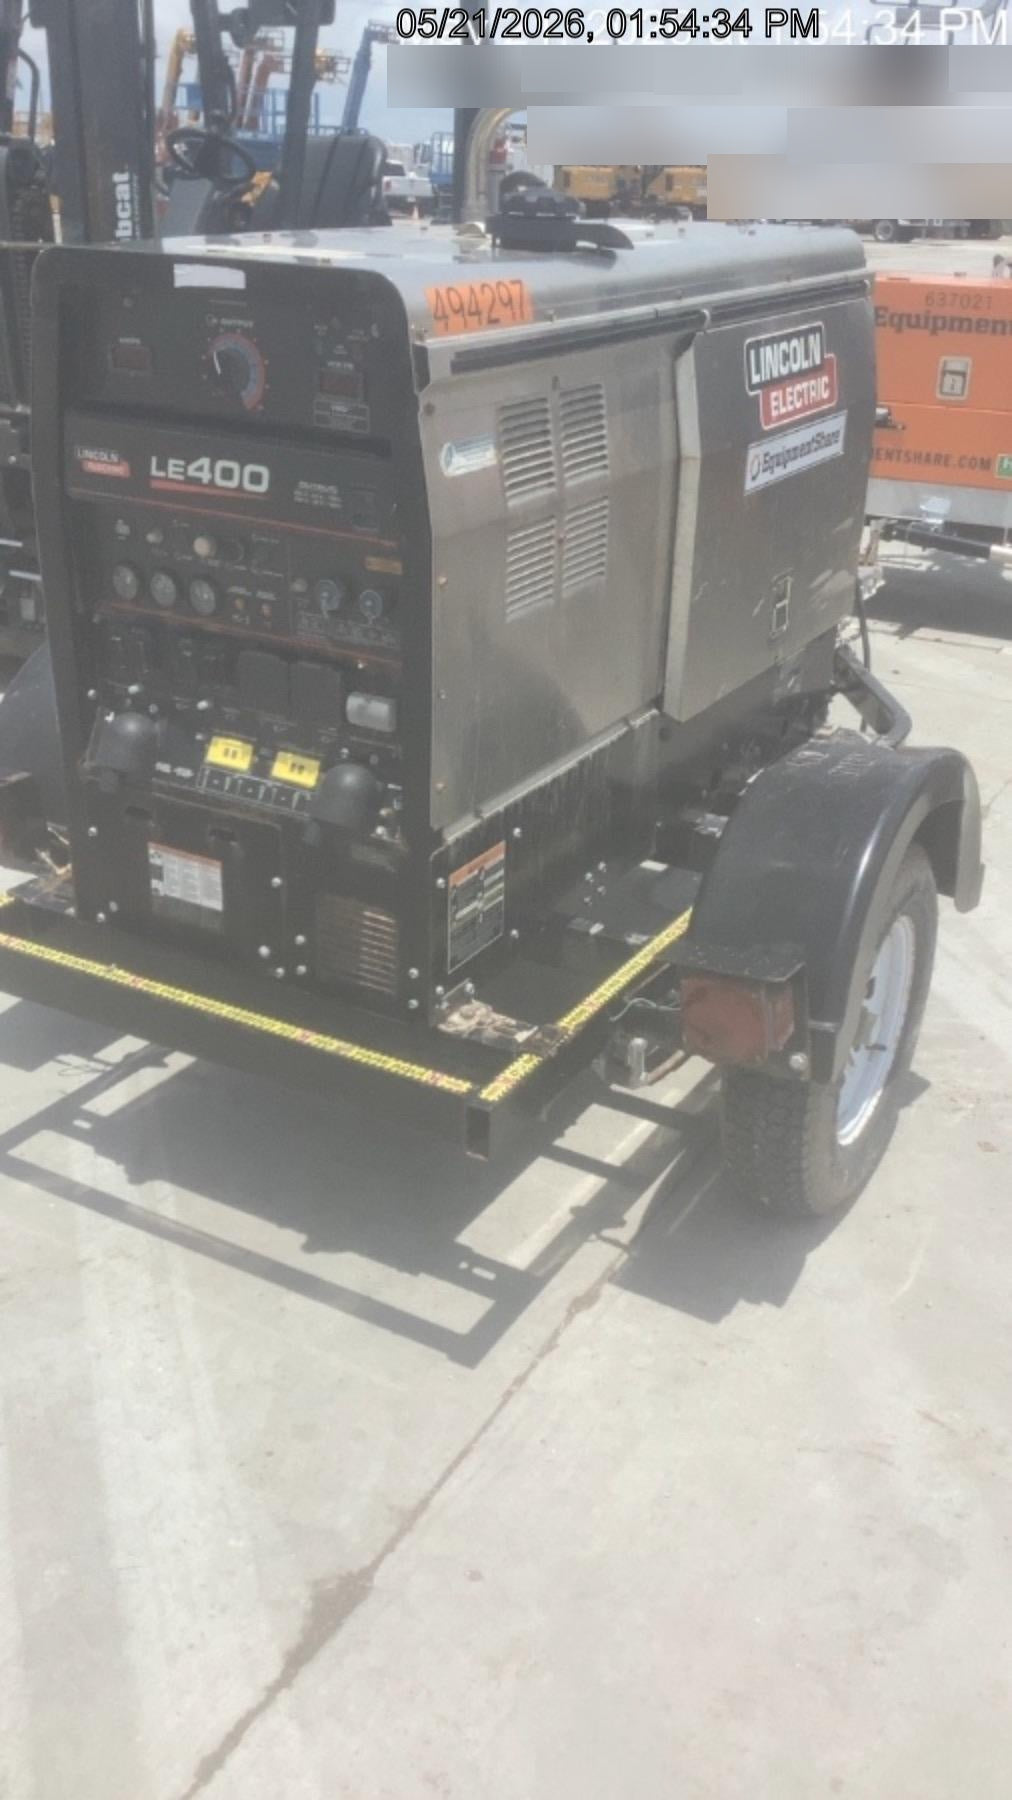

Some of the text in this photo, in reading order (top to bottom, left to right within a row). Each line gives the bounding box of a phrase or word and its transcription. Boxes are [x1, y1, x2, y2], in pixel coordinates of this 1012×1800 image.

[112, 171, 133, 240] bcat
[432, 279, 526, 332] 494297
[924, 290, 993, 311] 637021
[749, 332, 822, 385] LINCOLN
[769, 375, 830, 418] ELECTRIC
[761, 429, 841, 475] EquipmentShare
[870, 446, 992, 471] ENTSHARE.COM
[150, 455, 271, 494] LE400
